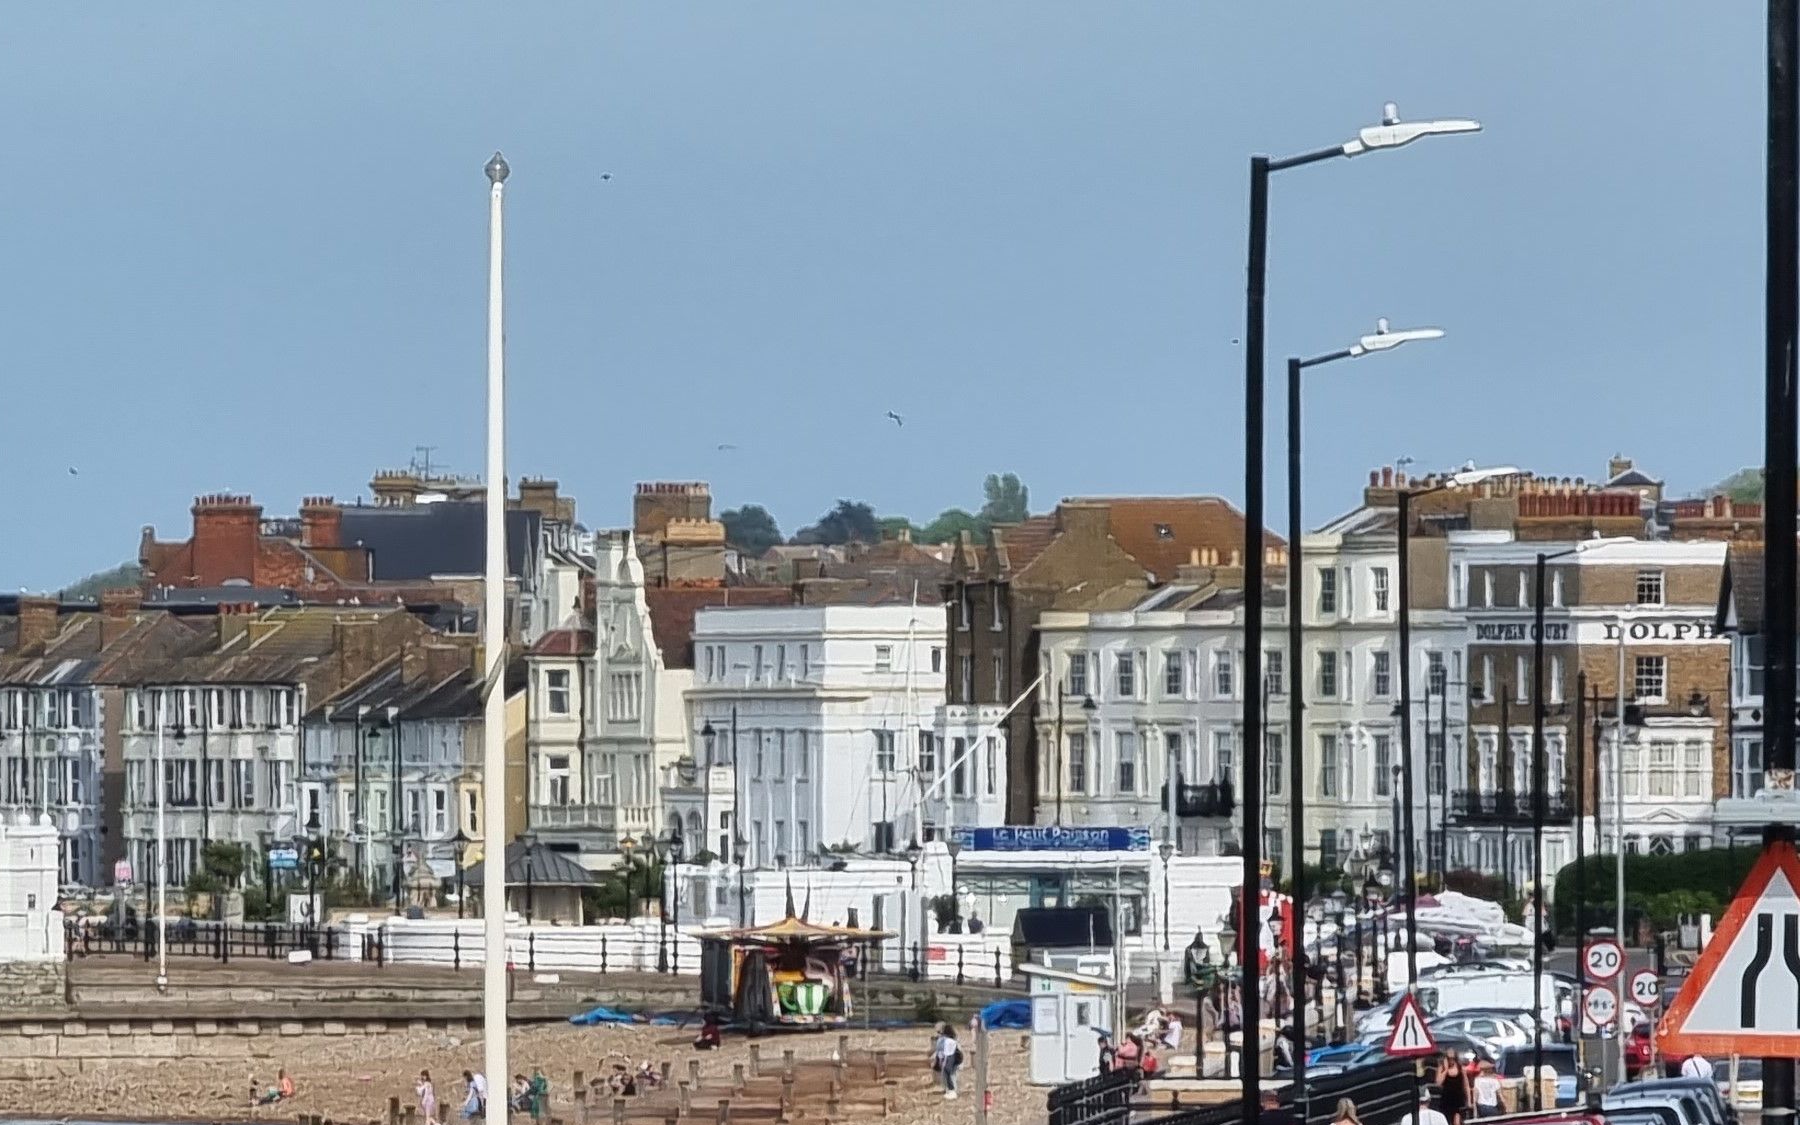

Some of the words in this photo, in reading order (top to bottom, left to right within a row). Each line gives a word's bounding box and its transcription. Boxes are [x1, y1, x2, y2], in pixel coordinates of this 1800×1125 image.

[1476, 623, 1527, 640] DOLPHIN
[1530, 623, 1569, 640] CURT
[1591, 952, 1618, 968] 20
[1636, 982, 1659, 996] 20
